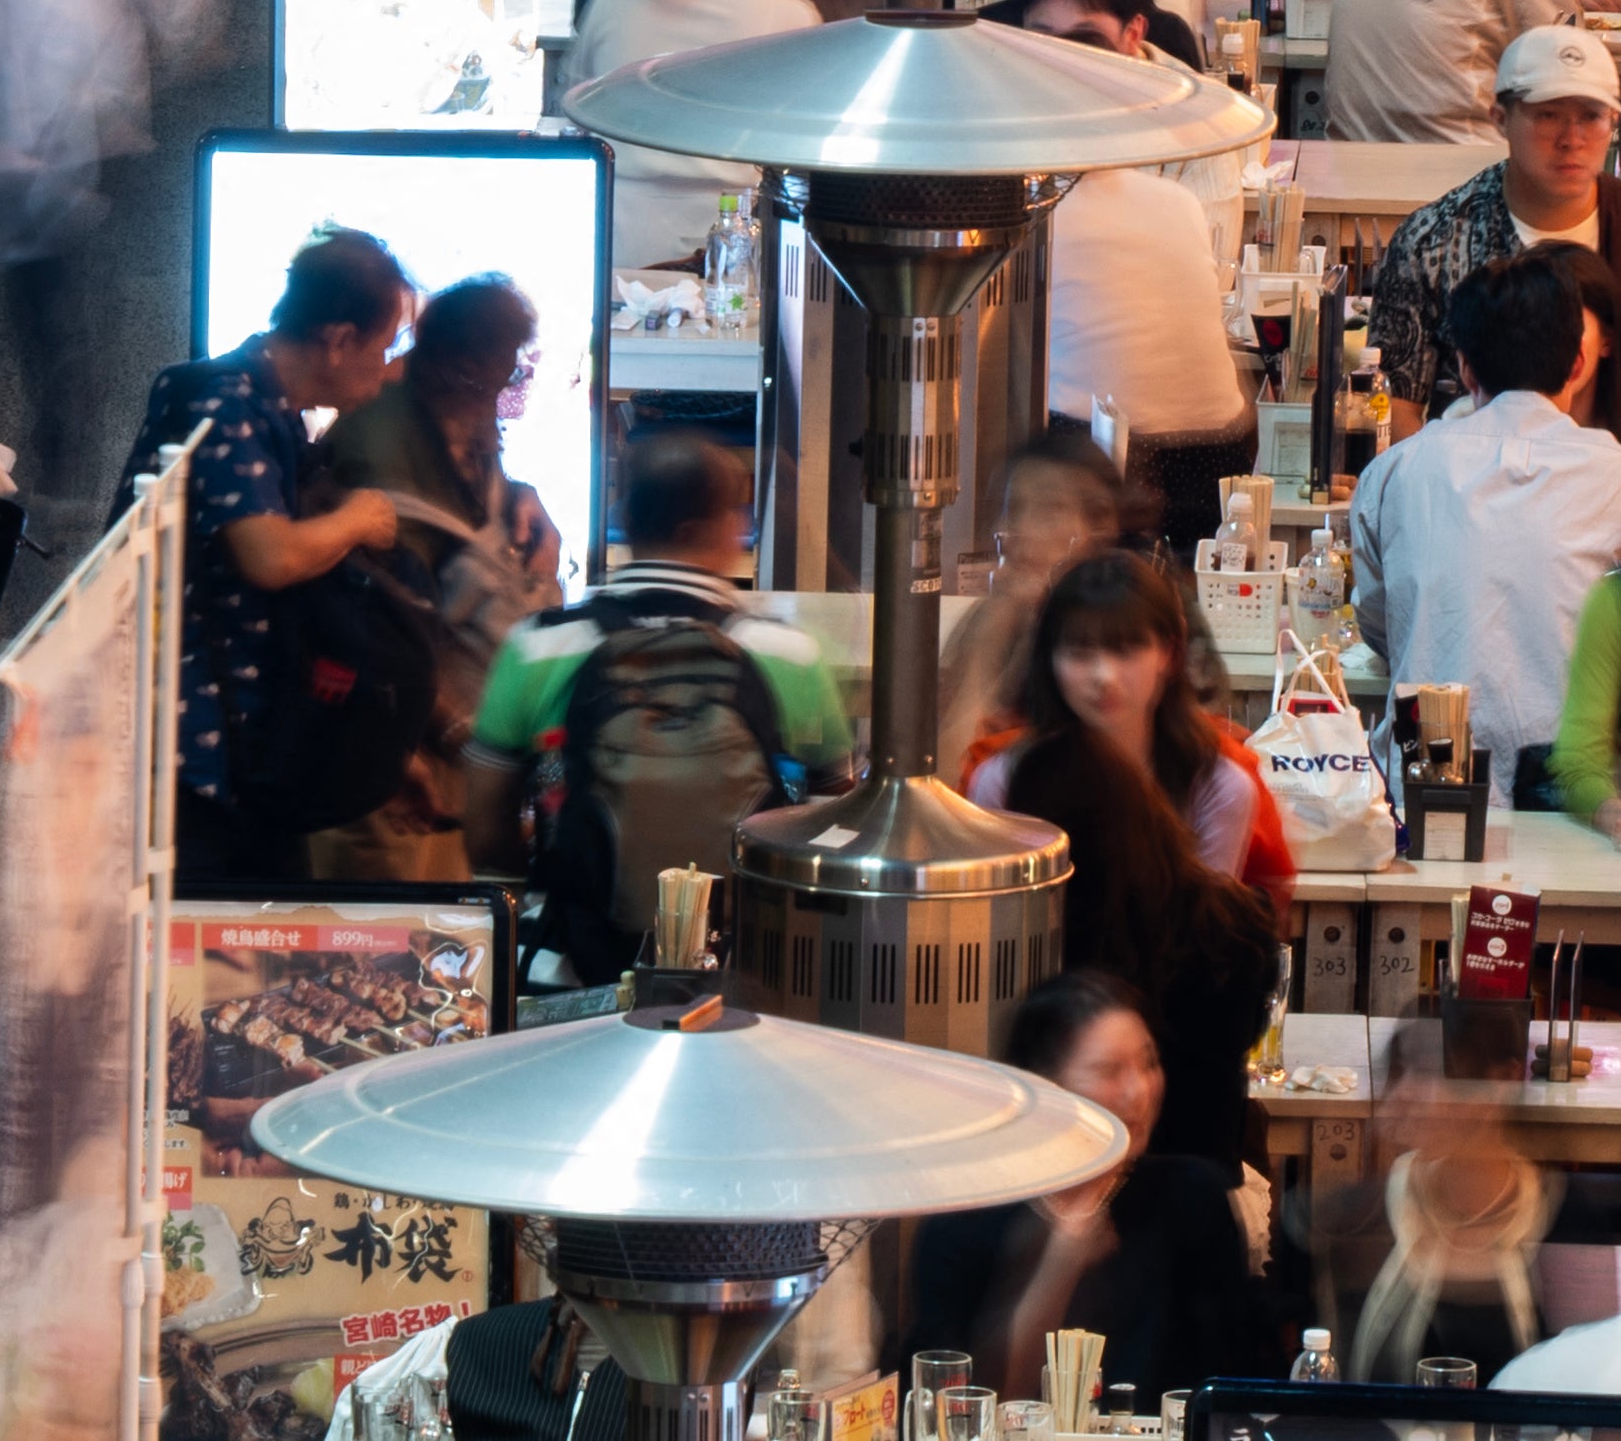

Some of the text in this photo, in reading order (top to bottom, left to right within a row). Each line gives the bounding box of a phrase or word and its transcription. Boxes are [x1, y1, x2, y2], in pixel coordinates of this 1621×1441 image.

[220, 929, 375, 949] 焼鳥盛合せ 899円
[1312, 957, 1347, 977] 303
[1379, 954, 1415, 976] 302
[1316, 1121, 1357, 1141] 203
[323, 1210, 465, 1285] 布袋
